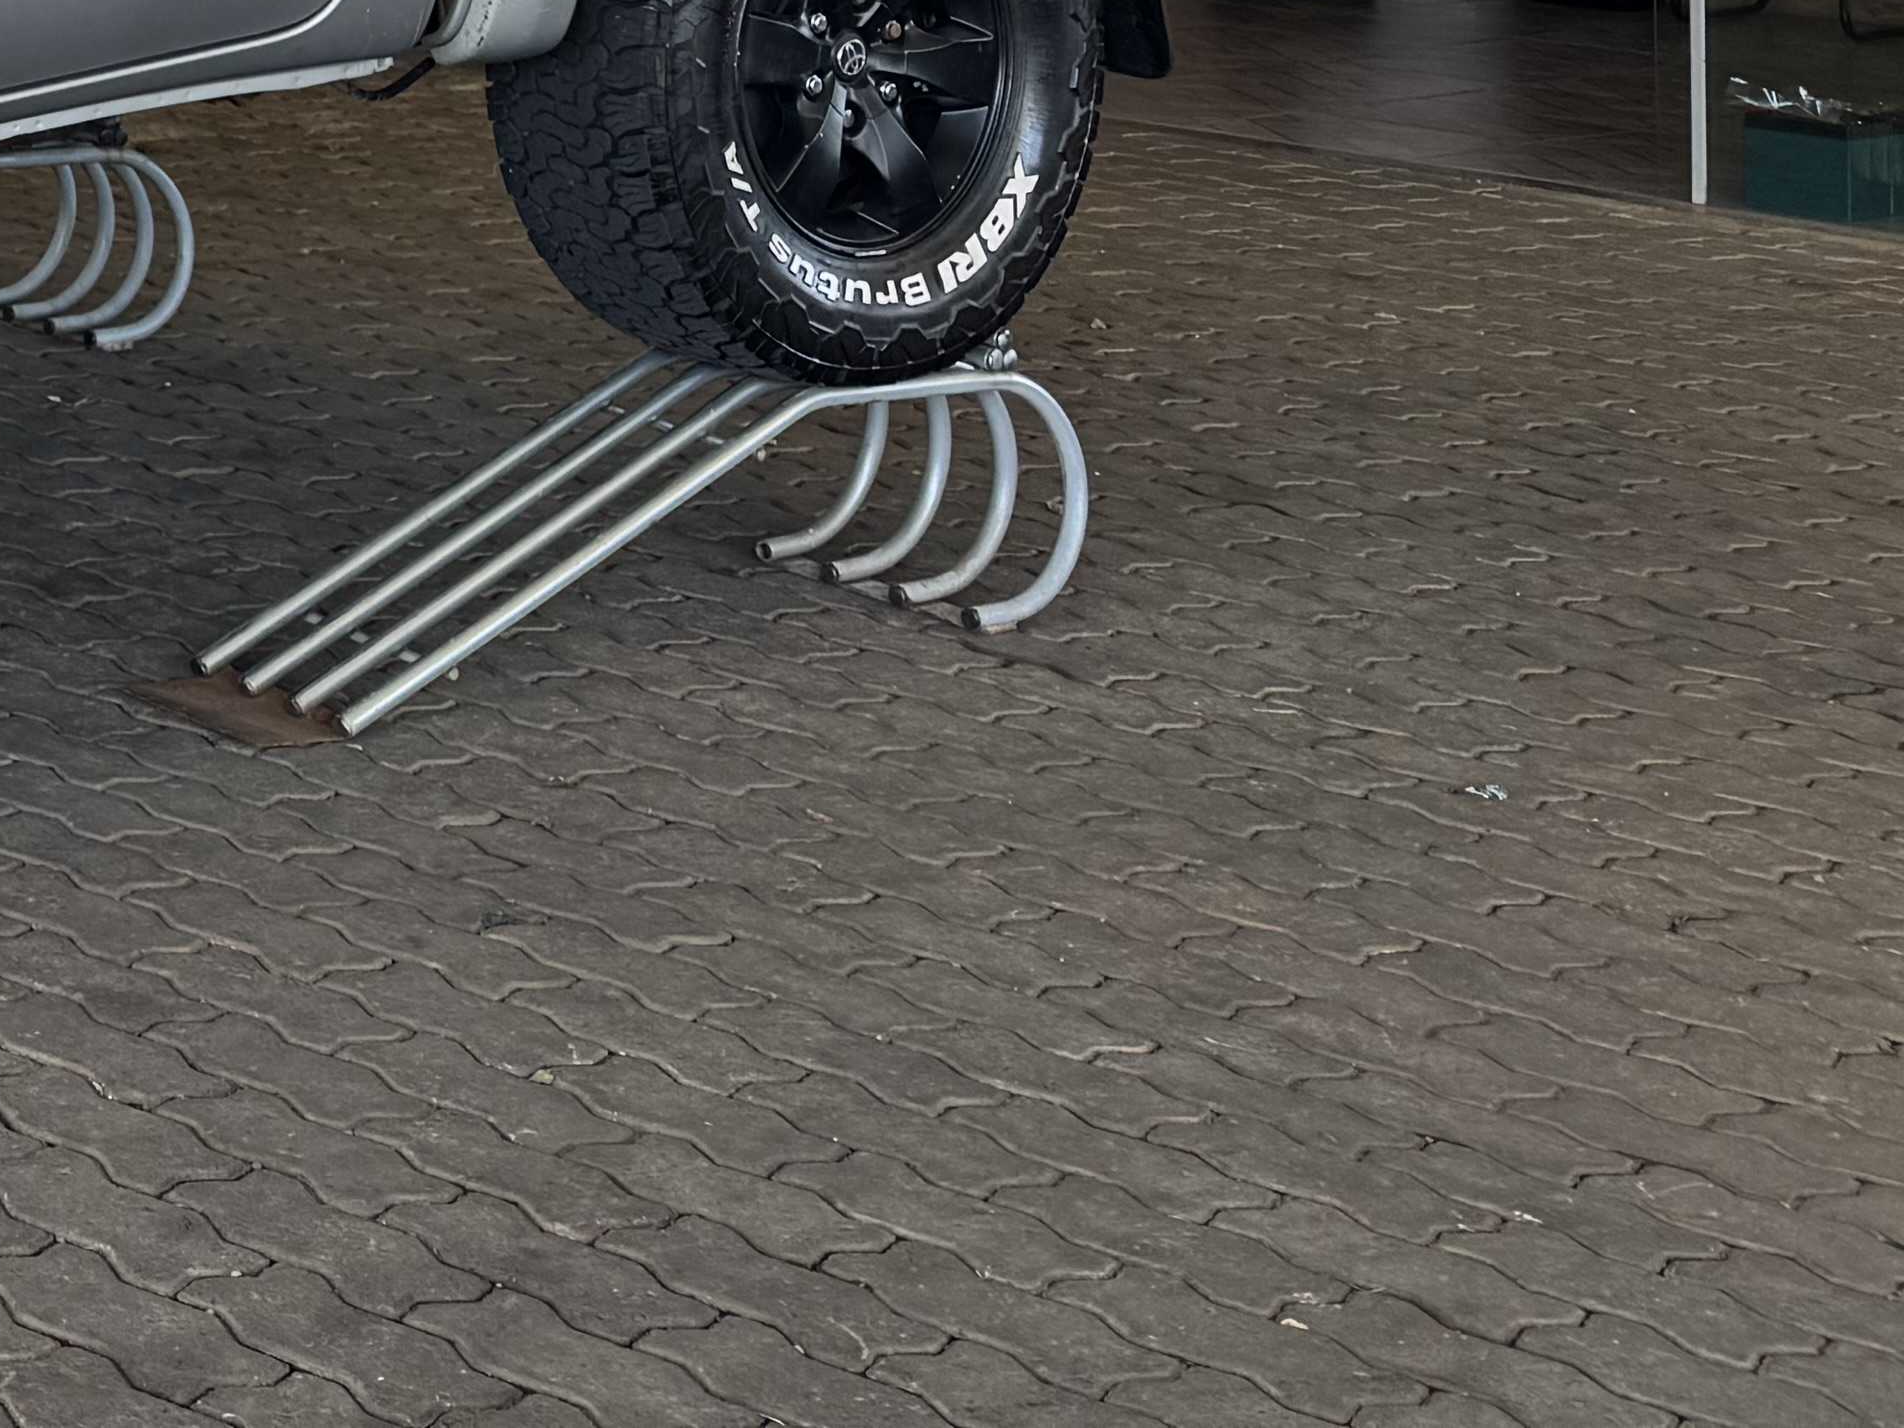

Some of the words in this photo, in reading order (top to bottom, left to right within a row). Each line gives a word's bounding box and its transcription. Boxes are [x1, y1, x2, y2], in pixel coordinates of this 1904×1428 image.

[723, 142, 761, 232] T/A
[937, 152, 1042, 295] XBRI
[767, 232, 931, 307] Brutus
